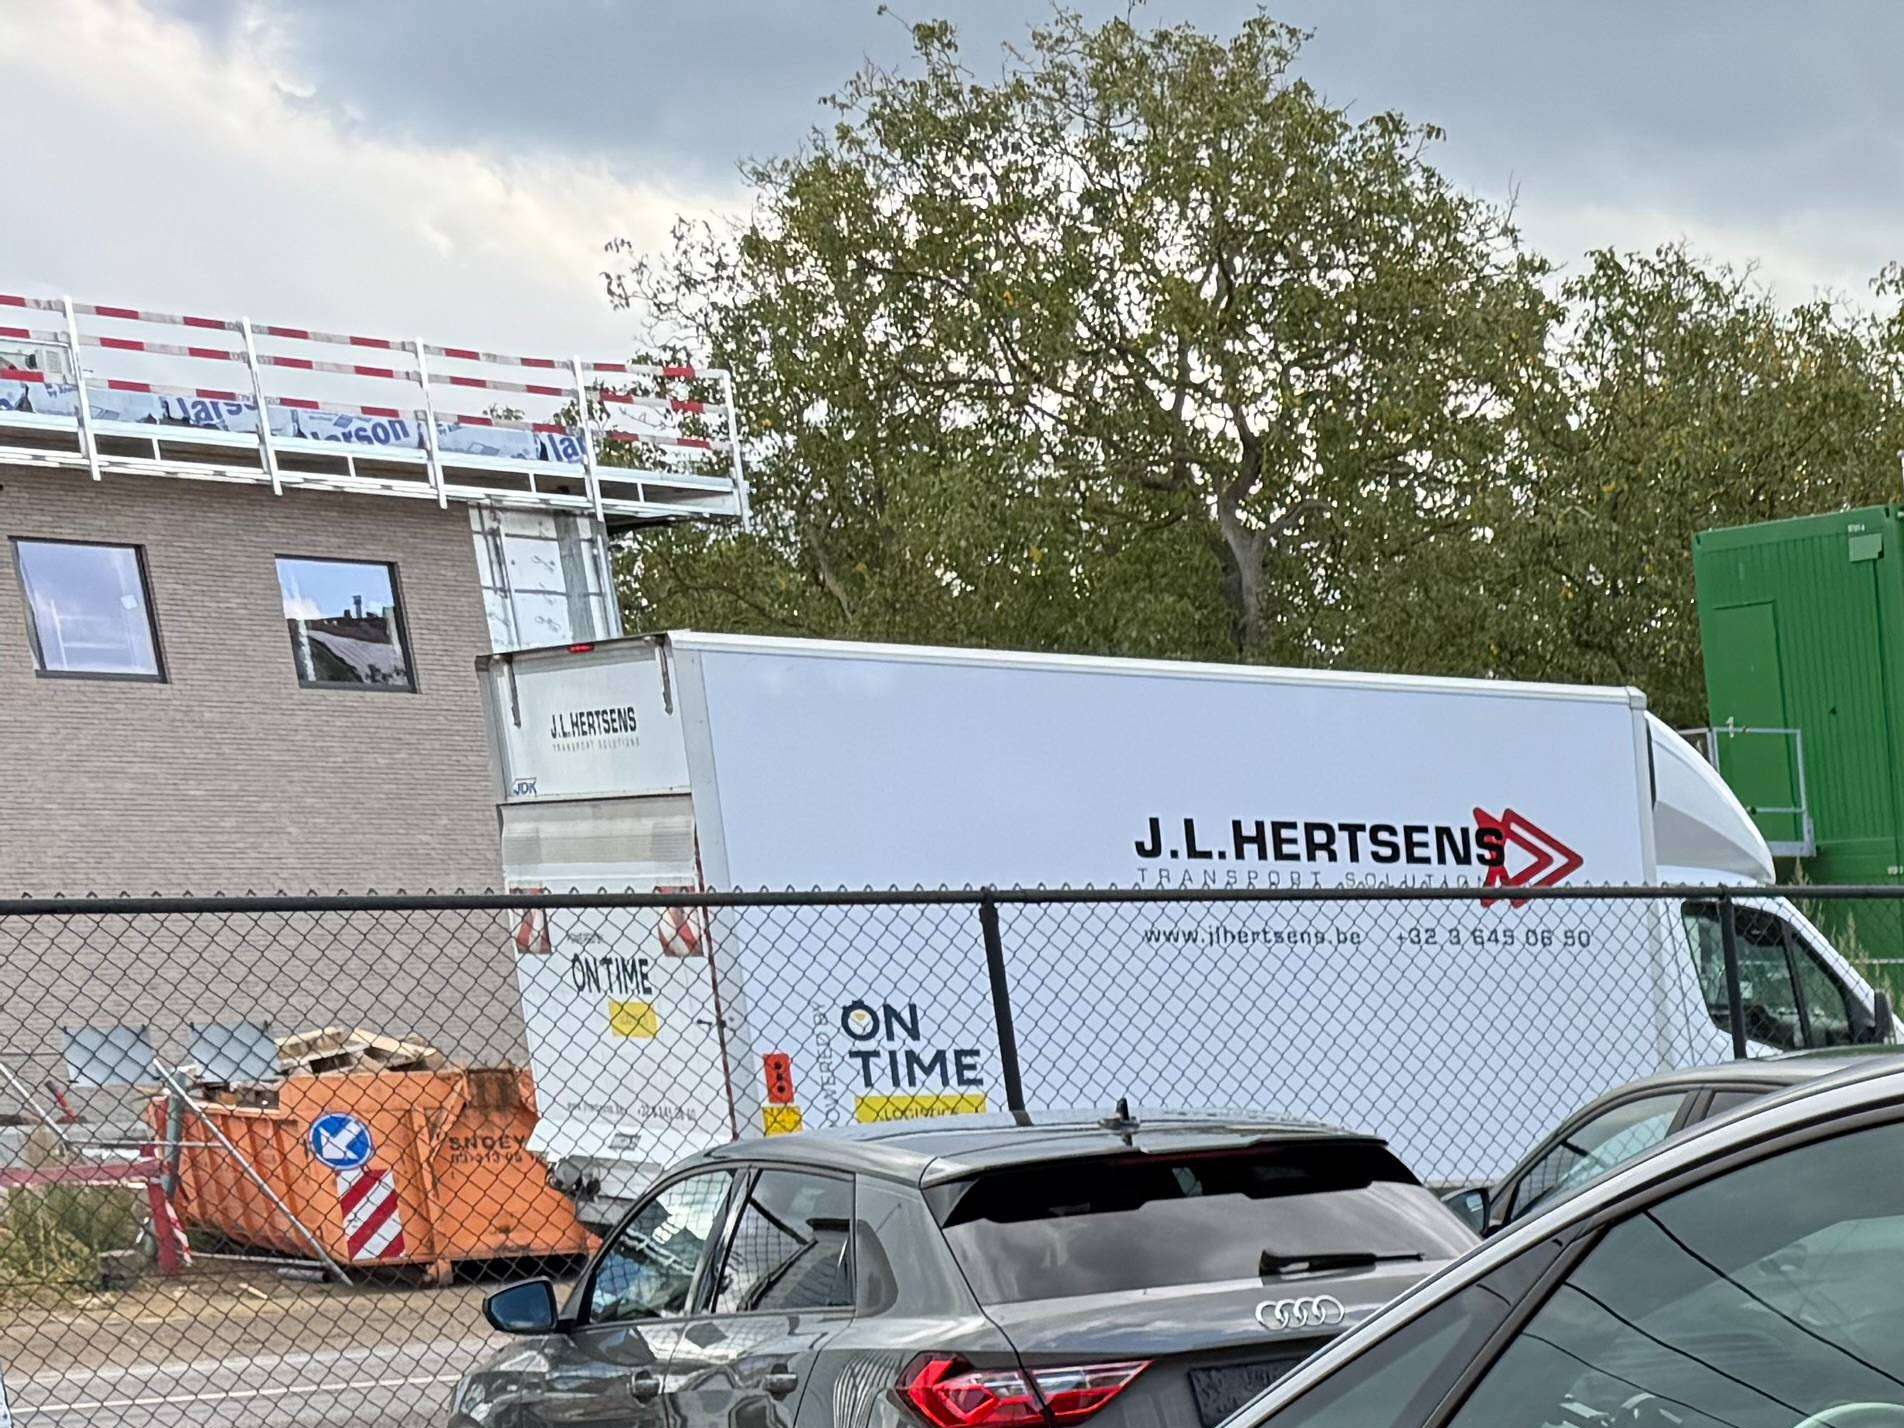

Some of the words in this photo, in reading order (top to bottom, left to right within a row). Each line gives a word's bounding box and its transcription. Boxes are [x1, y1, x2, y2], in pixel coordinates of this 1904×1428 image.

[570, 953, 600, 994] ON
[600, 957, 653, 995] TIME
[841, 1000, 921, 1041] ON
[849, 1050, 983, 1088] TIME
